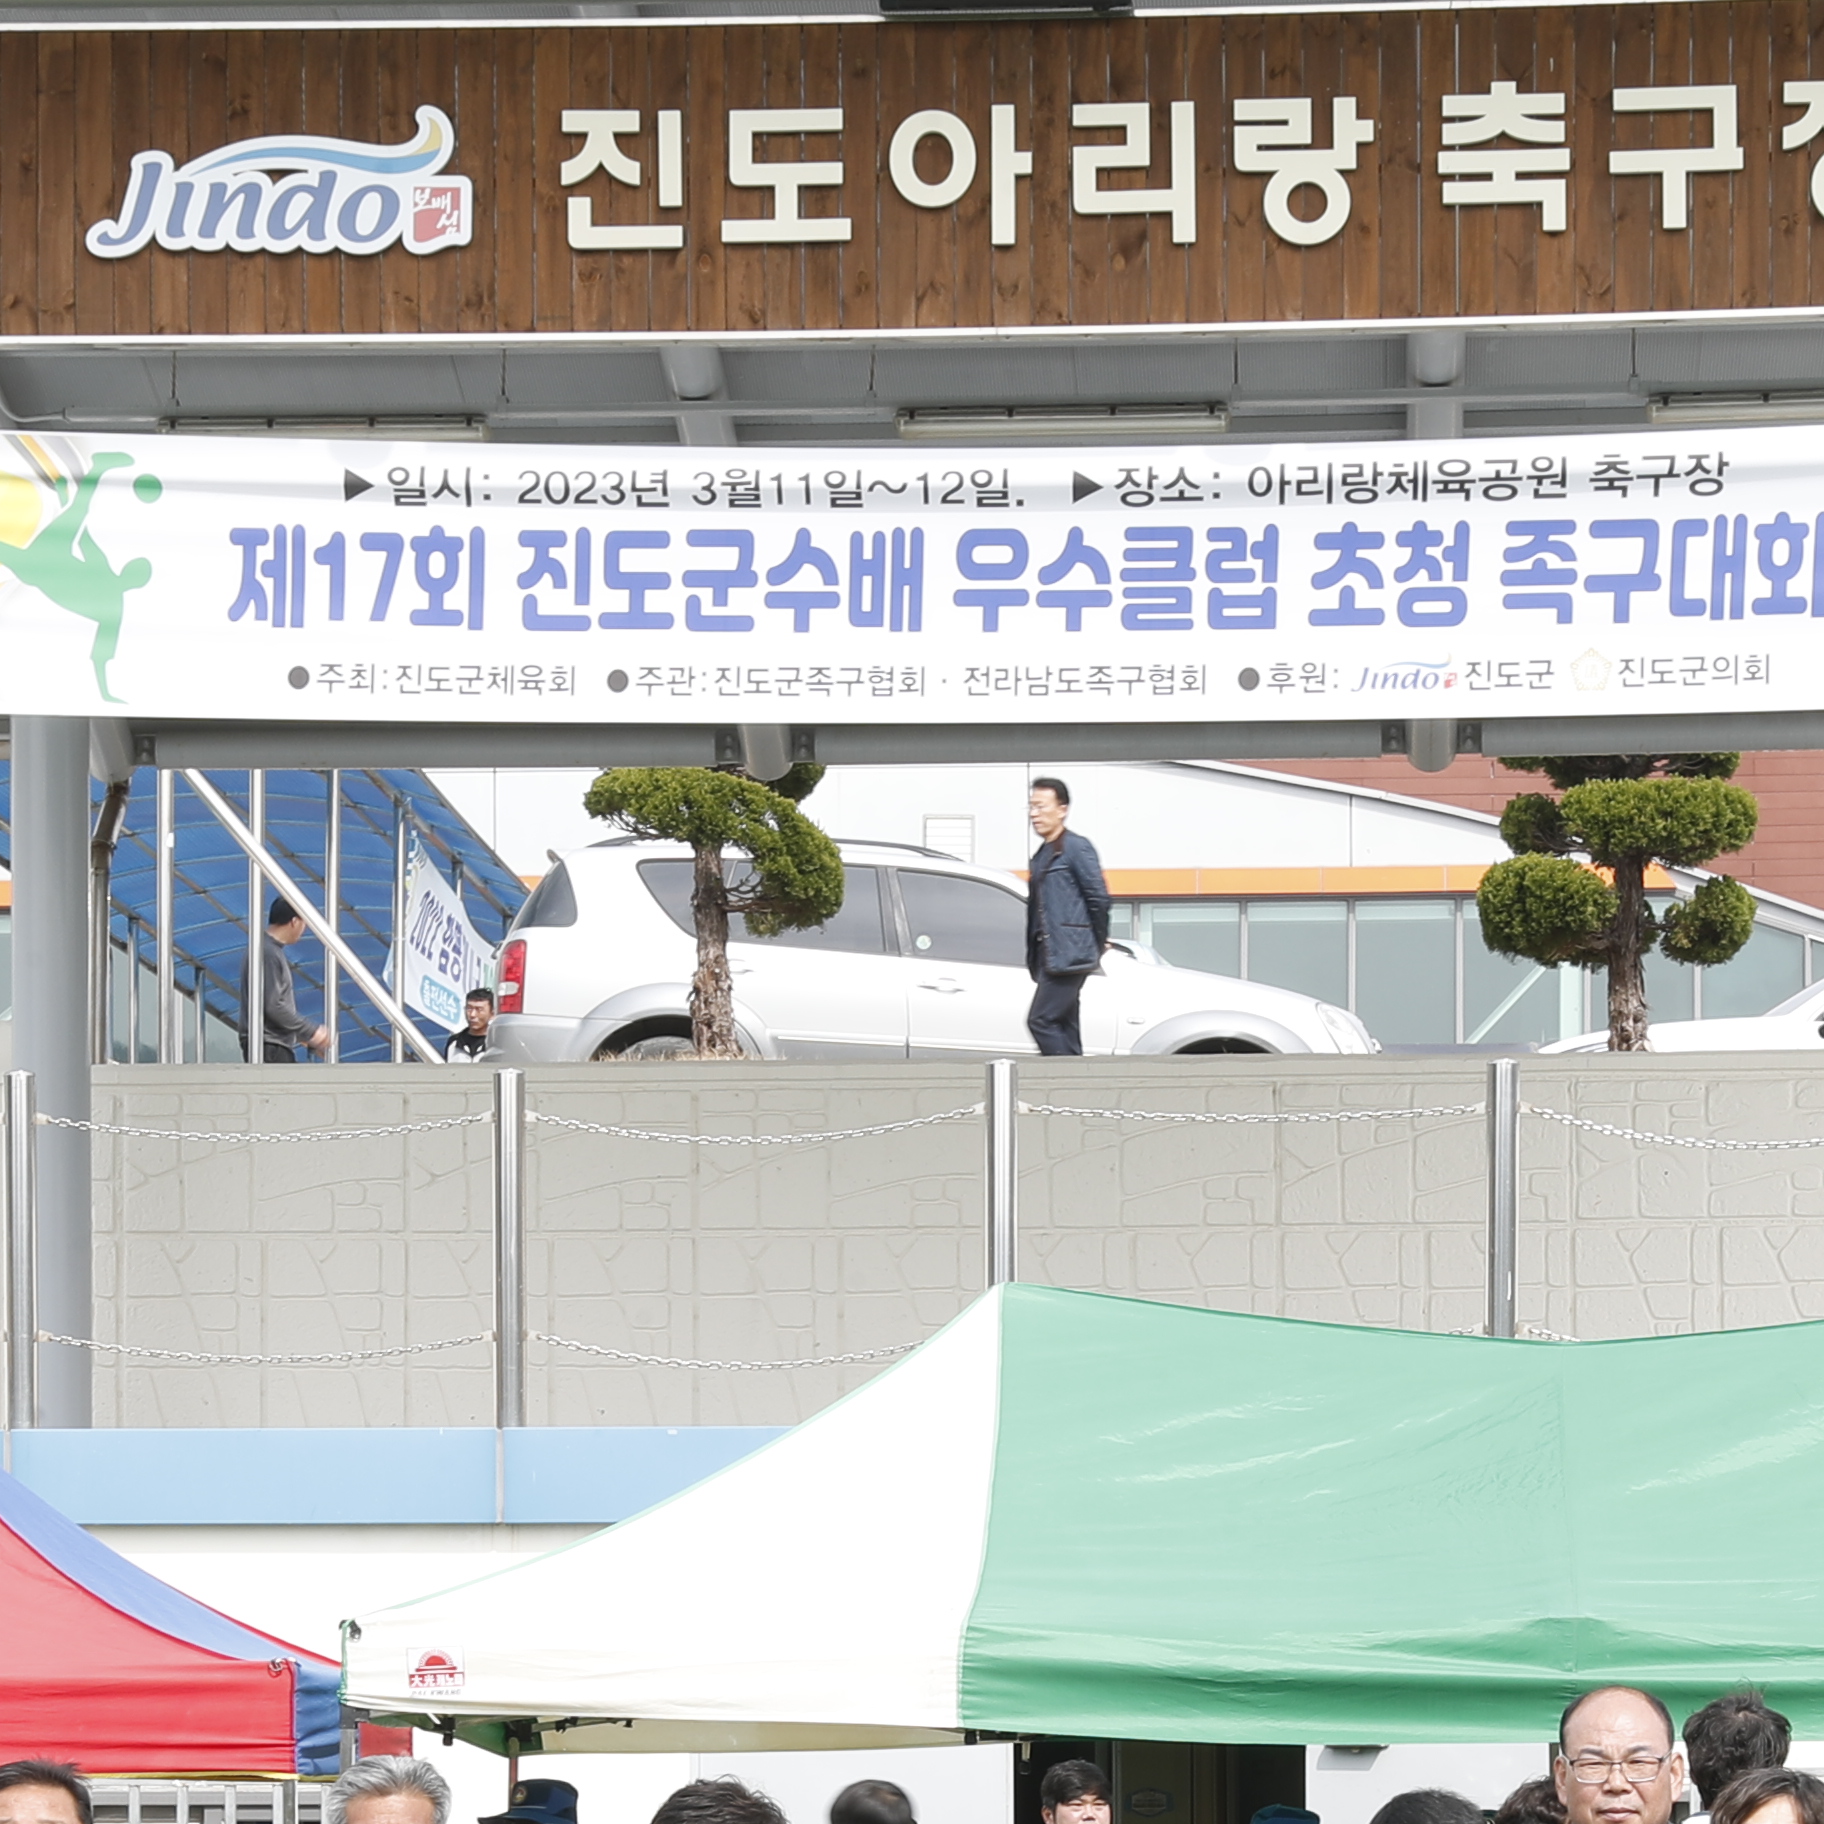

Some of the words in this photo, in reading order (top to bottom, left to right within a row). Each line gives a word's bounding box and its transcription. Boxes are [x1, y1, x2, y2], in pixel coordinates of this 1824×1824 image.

[92, 160, 402, 246] Jindo
[560, 95, 1375, 250] 진도아리랑
[386, 465, 492, 508] 일시:
[517, 469, 672, 507] 2023년
[1113, 465, 1222, 508] 장소:
[1246, 455, 1569, 506] 아리랑체육공원
[1587, 450, 1731, 498] 축구장
[227, 523, 486, 632] 제17회
[516, 525, 925, 633] 진도군수배
[952, 522, 1280, 633] 우수클럽
[1307, 519, 1471, 629] 초청
[962, 664, 1208, 698] 전라남도족구협회
[1463, 658, 1556, 693] 진도군
[1617, 652, 1773, 689] 진도군의회
